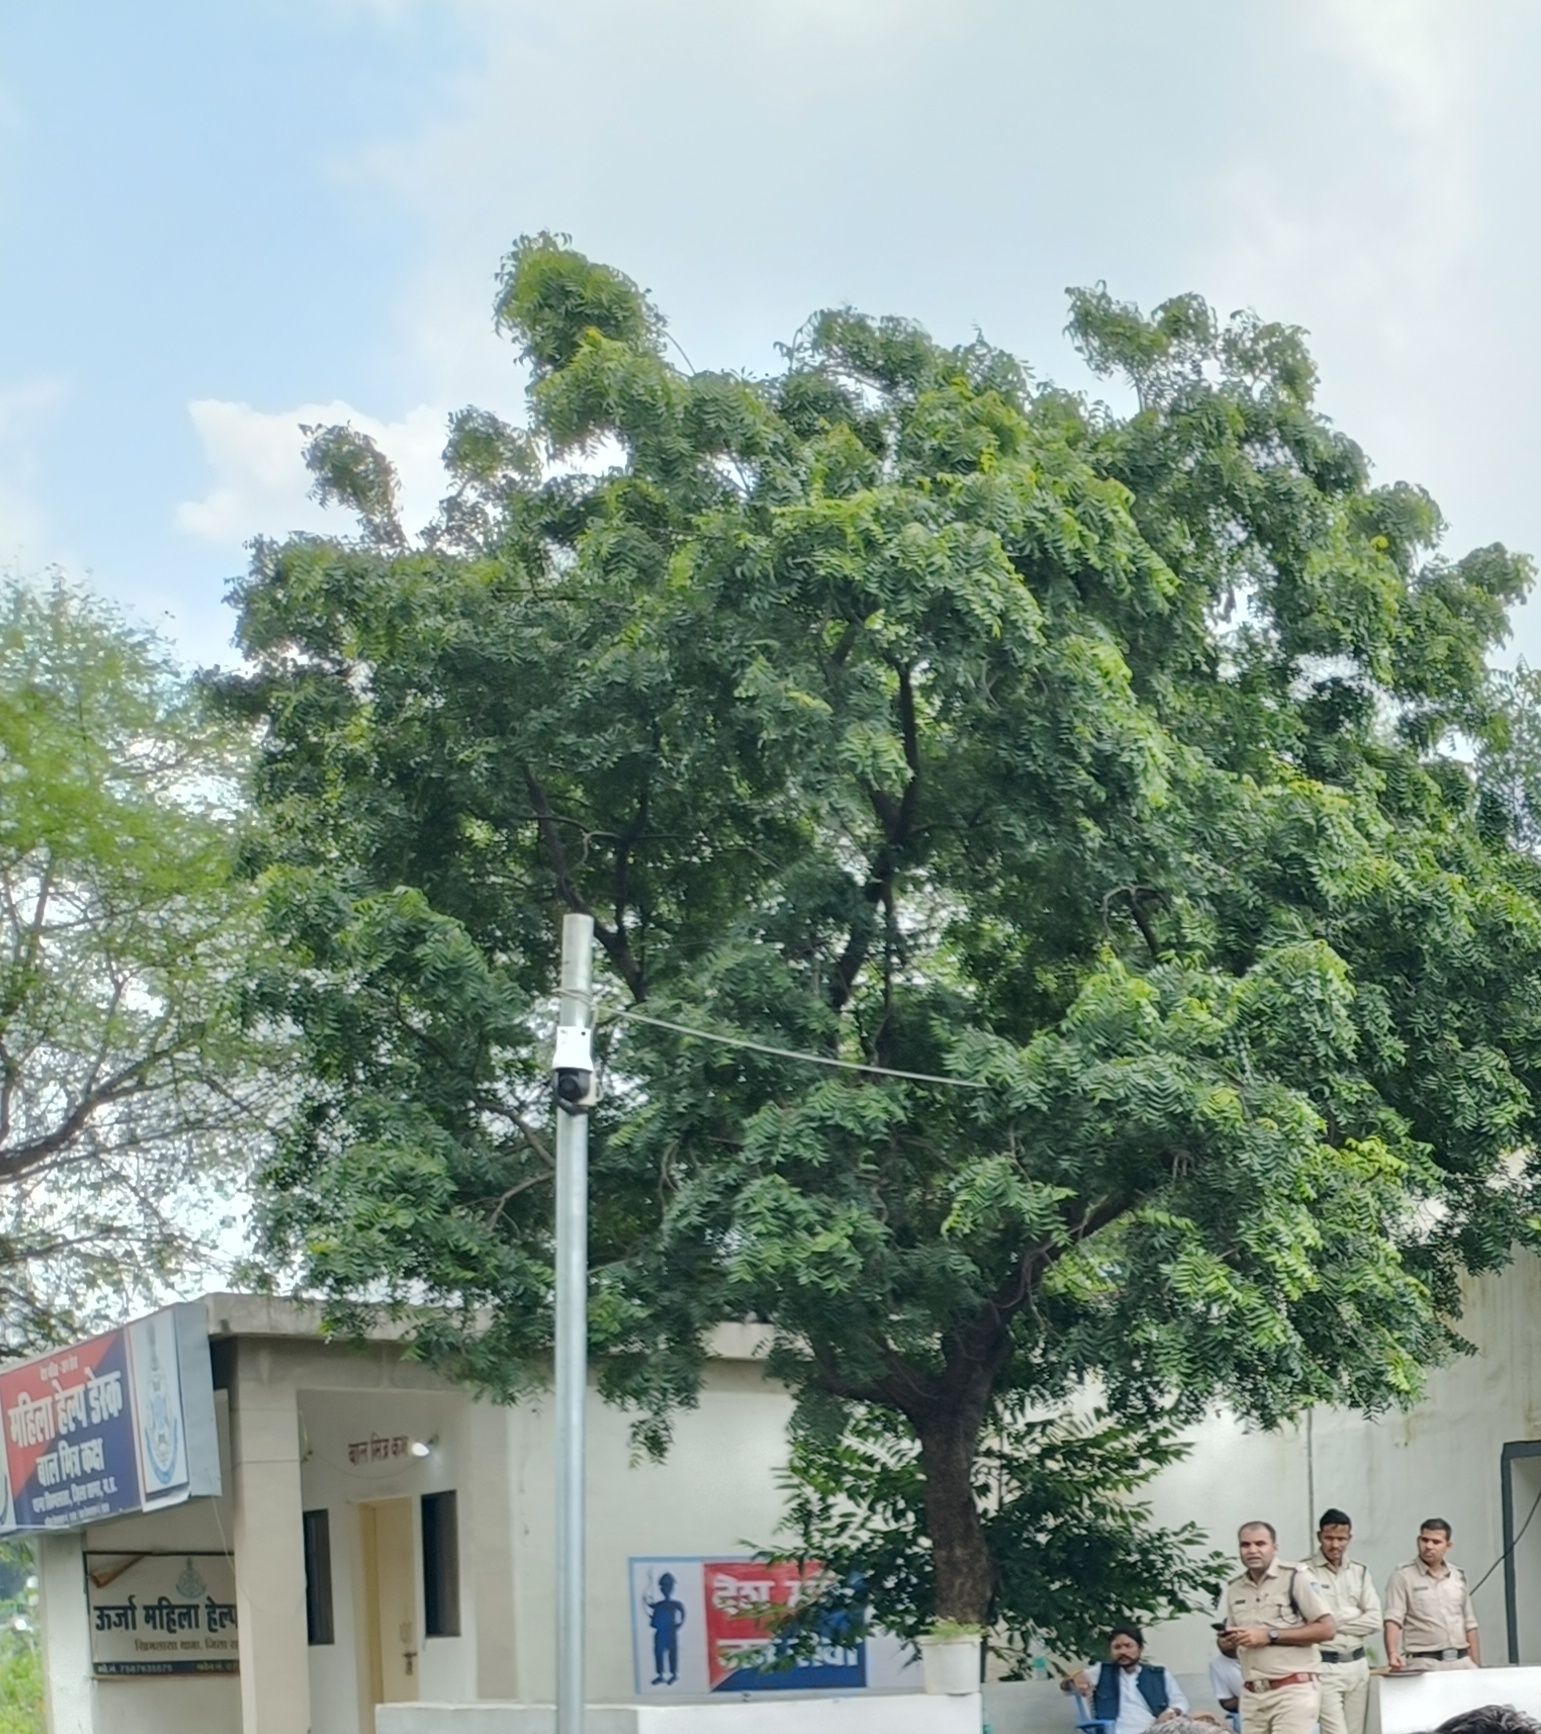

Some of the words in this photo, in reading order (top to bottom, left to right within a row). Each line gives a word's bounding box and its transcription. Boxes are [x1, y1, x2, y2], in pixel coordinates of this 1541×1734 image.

[8, 1391, 56, 1448] महिला
[51, 1379, 88, 1436] हेल्प
[84, 1366, 123, 1425] डेस्क
[35, 1452, 61, 1487] बाल
[93, 1594, 137, 1631] ऊर्जा
[143, 1596, 200, 1634] महिला
